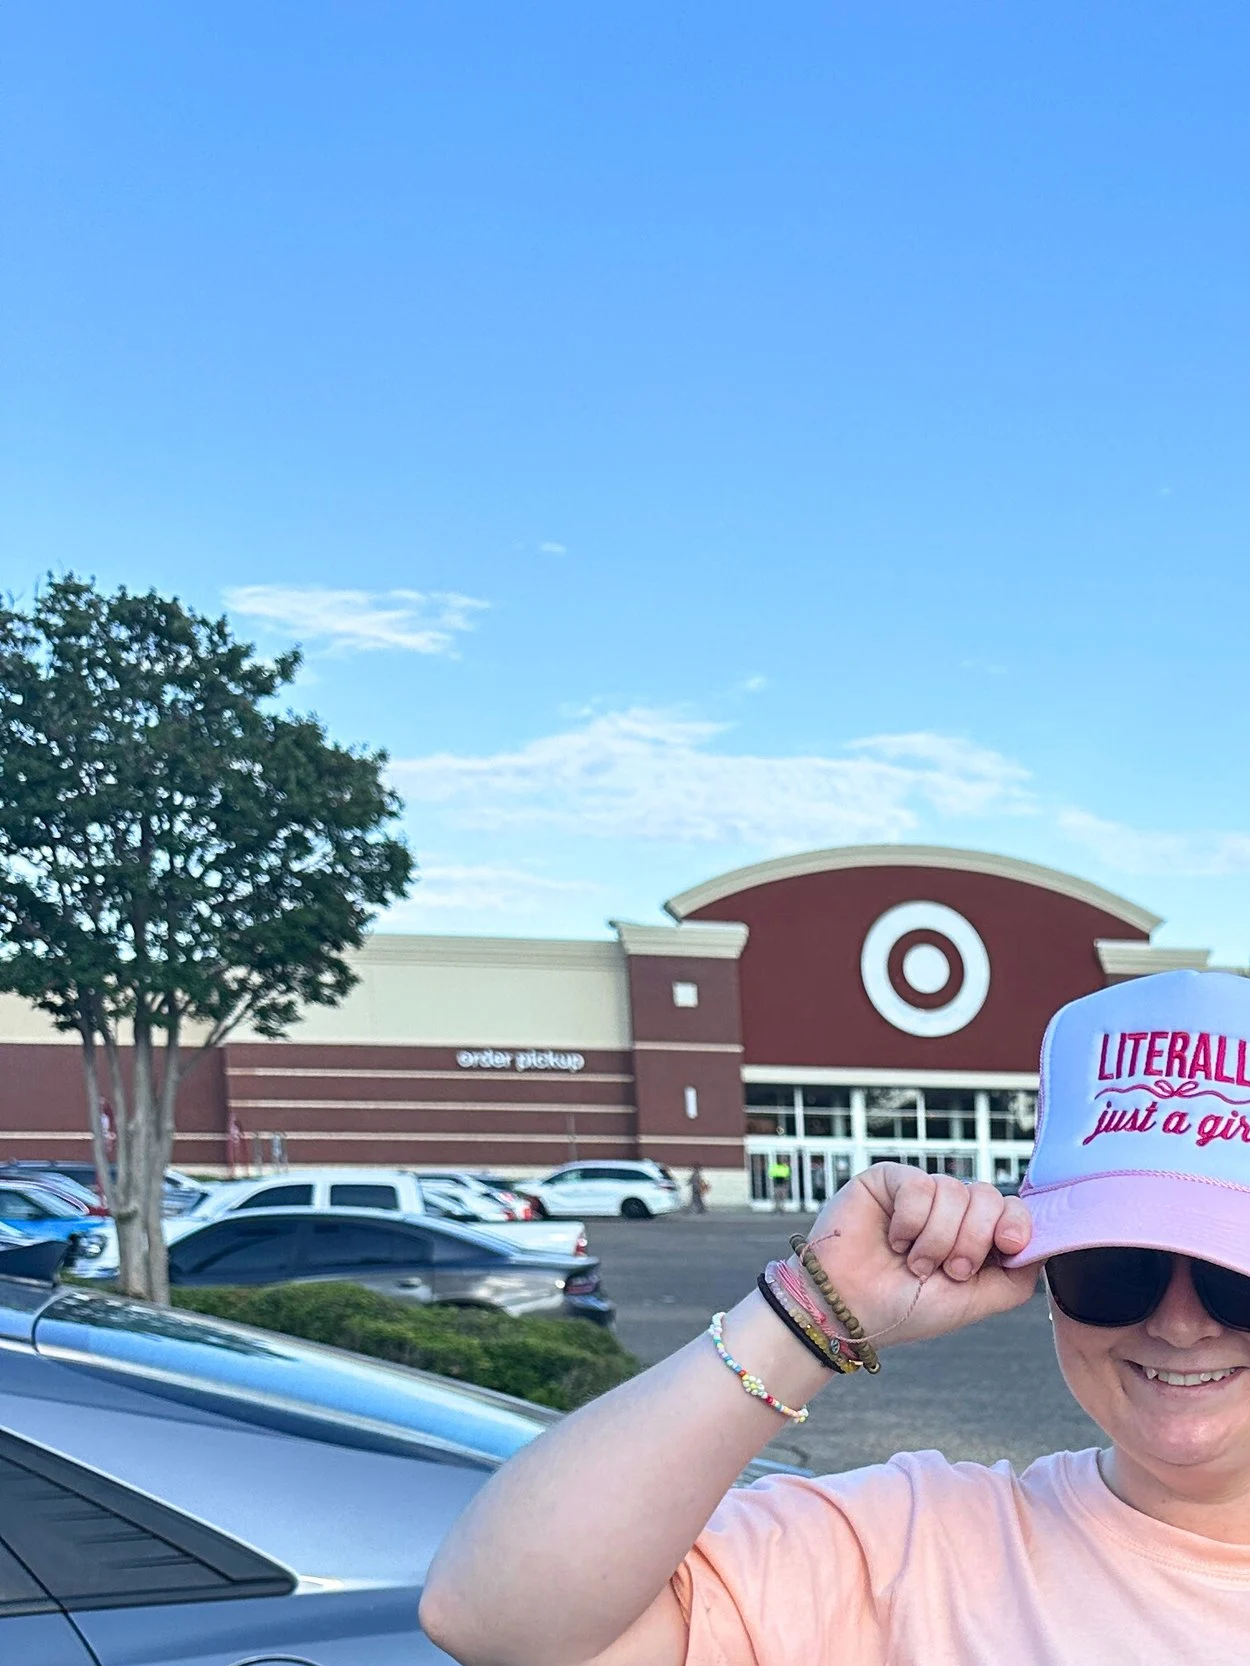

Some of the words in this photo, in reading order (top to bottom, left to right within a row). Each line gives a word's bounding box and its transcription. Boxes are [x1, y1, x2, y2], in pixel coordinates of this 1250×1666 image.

[456, 1048, 513, 1069] order
[514, 1049, 585, 1073] pickup
[1082, 1100, 1159, 1147] just
[1161, 1110, 1193, 1136] a
